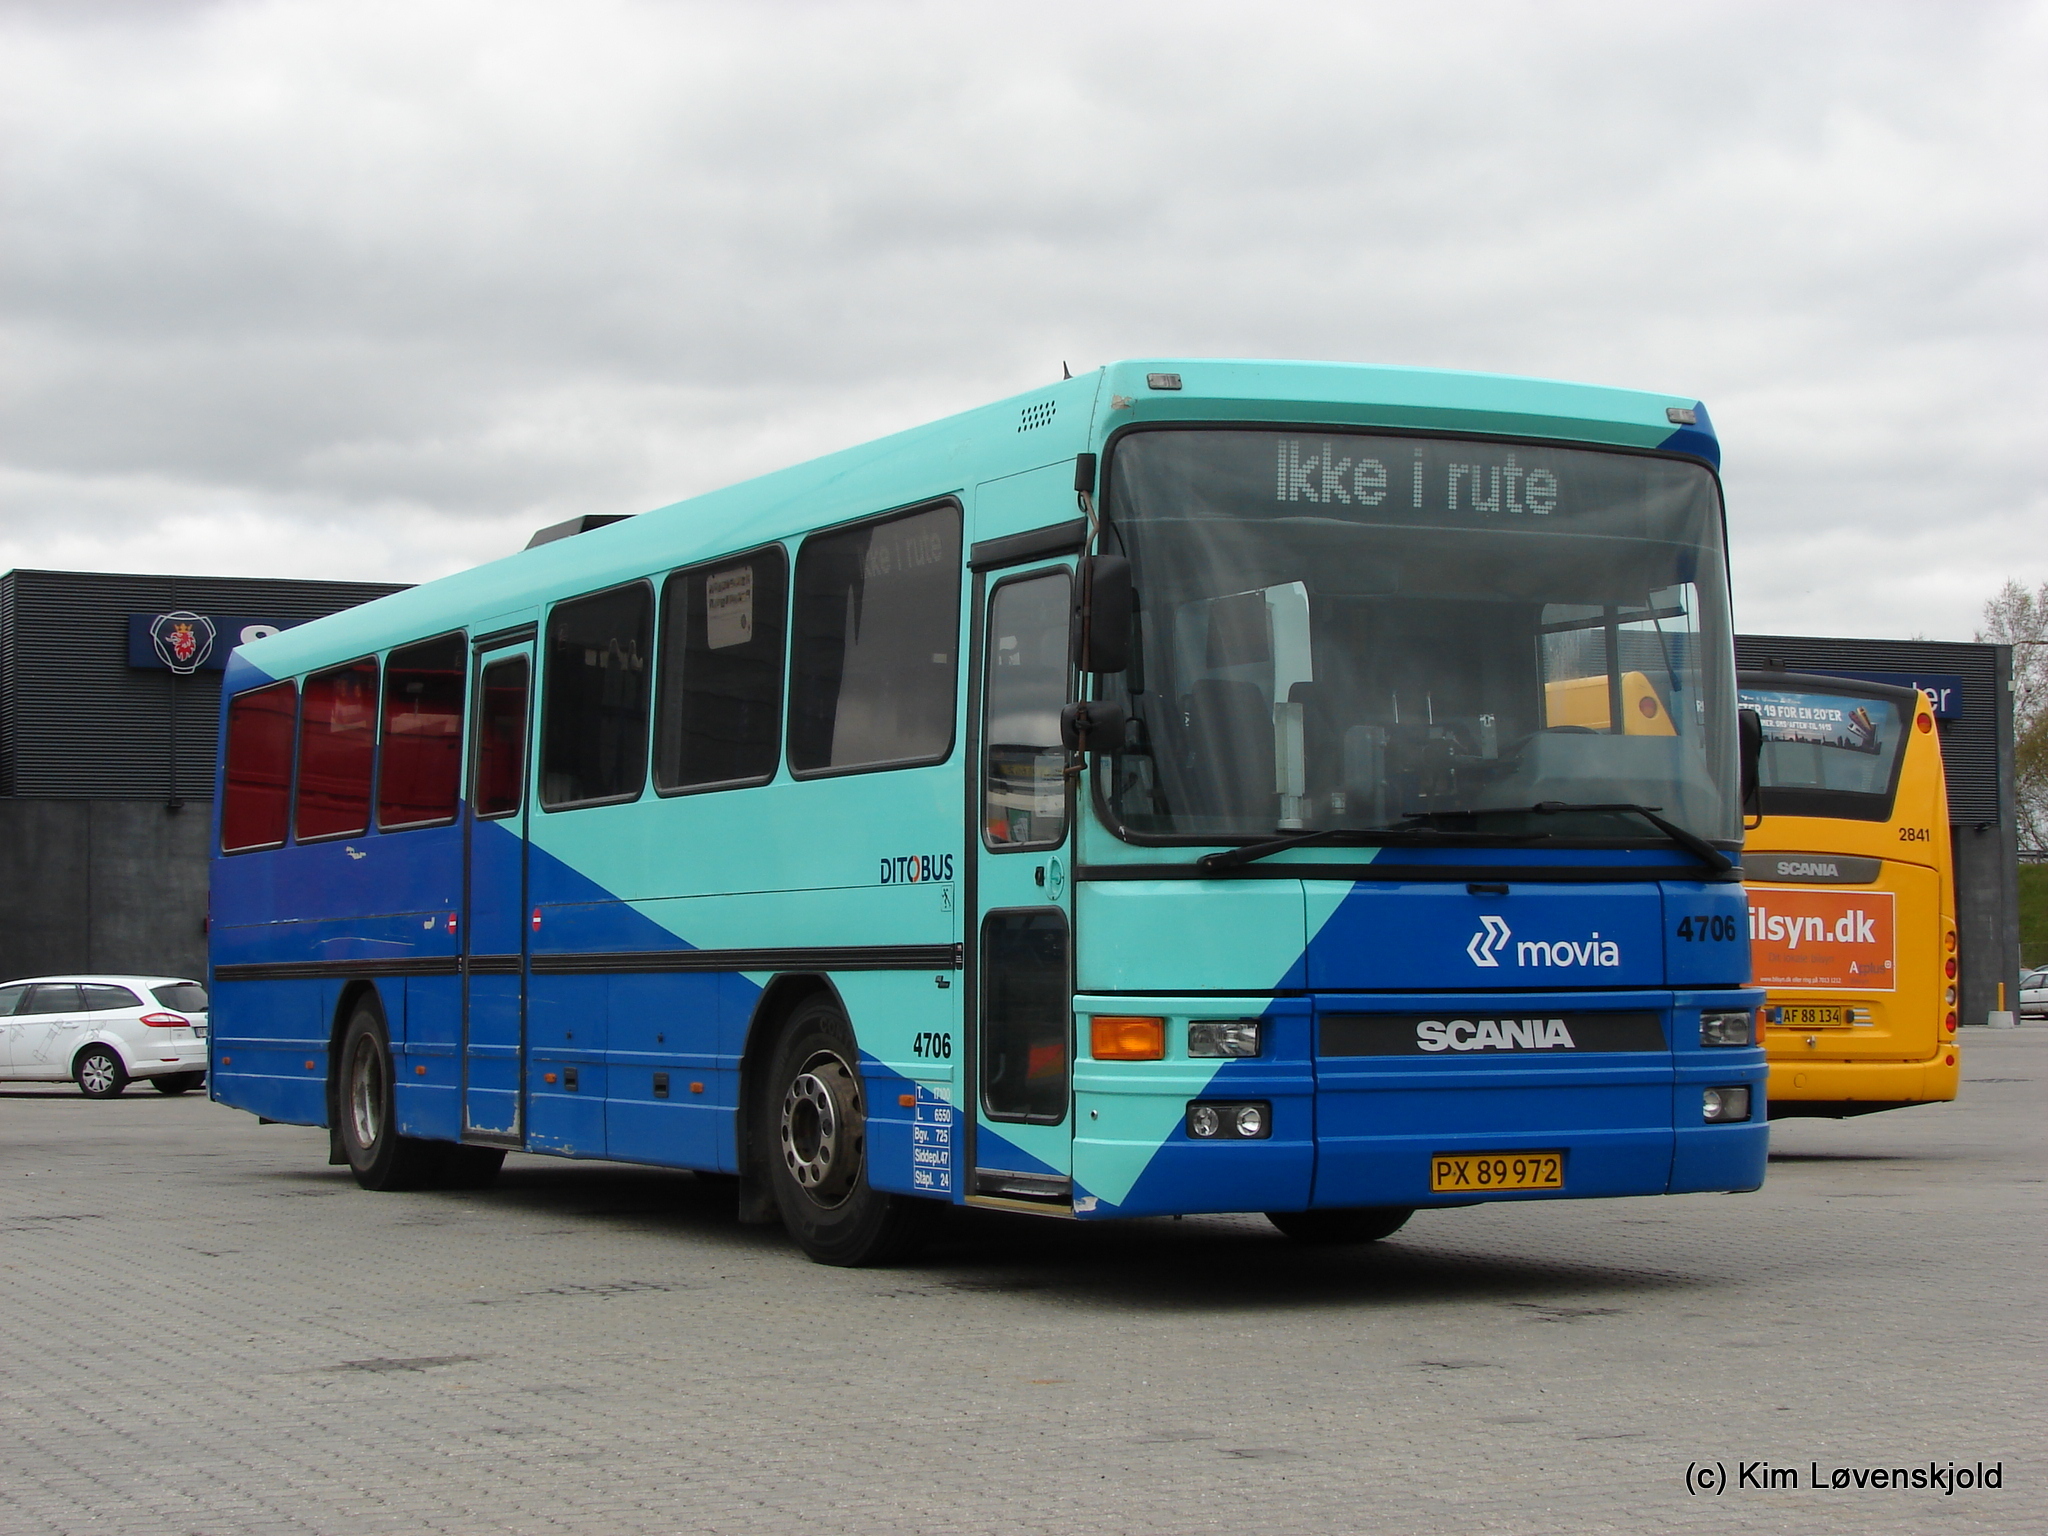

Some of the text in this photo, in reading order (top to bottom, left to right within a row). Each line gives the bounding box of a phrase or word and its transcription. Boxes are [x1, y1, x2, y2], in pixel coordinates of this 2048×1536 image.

[1277, 440, 1559, 515] Ikke i rute
[1912, 682, 1951, 712] er
[1763, 704, 1775, 717] 19
[1777, 705, 1797, 719] FOR
[1799, 707, 1812, 720] EN
[1813, 709, 1842, 722] 20'ER
[1899, 827, 1930, 842] 2841
[881, 853, 953, 884] DITOBUS
[1777, 861, 1839, 877] SCANIA
[1677, 915, 1736, 942] 4706
[1517, 932, 1619, 967] movia
[1783, 1009, 1798, 1022] AF
[1801, 1009, 1816, 1022] 88
[1819, 1009, 1839, 1022] 134
[913, 1032, 952, 1059] 4706
[1416, 1019, 1575, 1051] SCANIA
[934, 1108, 951, 1123] 6550
[914, 1127, 948, 1144] Bgv. 725
[940, 1173, 949, 1187] 24
[1436, 1161, 1470, 1186] PX
